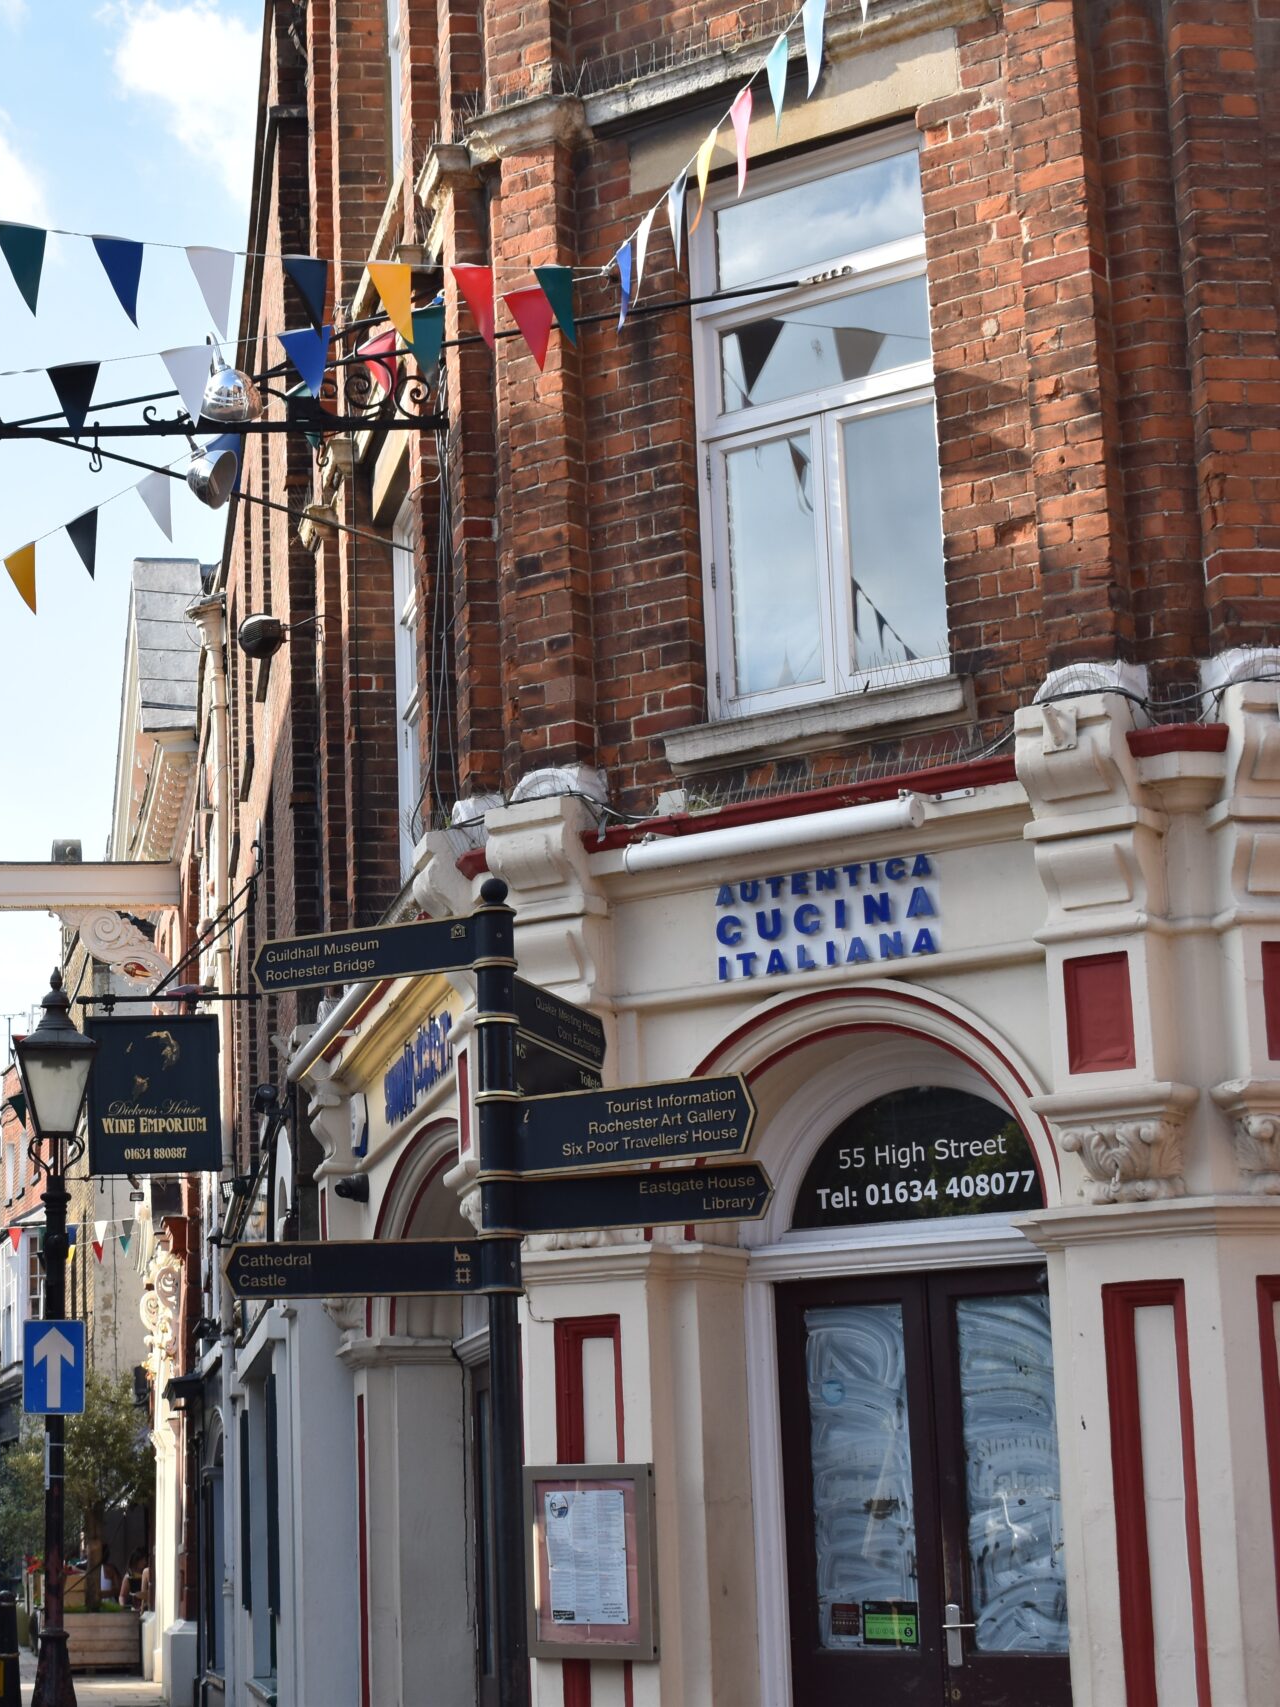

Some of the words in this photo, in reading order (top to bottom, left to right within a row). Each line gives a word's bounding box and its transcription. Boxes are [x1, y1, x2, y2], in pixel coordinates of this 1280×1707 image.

[716, 853, 932, 907] AUTENTICA
[716, 886, 935, 946] CUCINA
[266, 944, 320, 963] Guildhall
[324, 939, 380, 956] Museum
[718, 928, 937, 981] ITALIANA
[266, 964, 331, 982] Rochester
[333, 958, 376, 974] Bridge
[535, 997, 557, 1017] Quaker
[559, 1008, 581, 1031] Meeting
[583, 1020, 601, 1038] House
[557, 1025, 572, 1043] Corn
[573, 1034, 601, 1057] Exchange
[578, 1070, 600, 1089] Toilets
[160, 1099, 201, 1115] House
[606, 1098, 653, 1114] Tourist
[657, 1088, 737, 1109] Information
[101, 1117, 136, 1134] WINE
[139, 1117, 207, 1133] EMPORIUM
[588, 1116, 657, 1135] Rochester
[661, 1112, 682, 1127] Art
[687, 1108, 737, 1124] Gallery
[124, 1148, 151, 1160] 01634
[153, 1147, 187, 1159] 880887
[562, 1143, 583, 1156] Six
[587, 1139, 619, 1153] Poor
[622, 1131, 689, 1149] Travellers'
[692, 1128, 738, 1142] House
[839, 1147, 865, 1169] 55
[874, 1141, 925, 1169] High
[934, 1134, 1007, 1160] Street
[639, 1179, 704, 1195] Eastgate
[707, 1176, 756, 1190] House
[816, 1185, 858, 1210] Tel:
[865, 1179, 938, 1206] 01634
[945, 1170, 1035, 1198] 408077
[702, 1197, 756, 1210] Library
[239, 1252, 312, 1267] Cathedral
[239, 1273, 287, 1287] Castle
